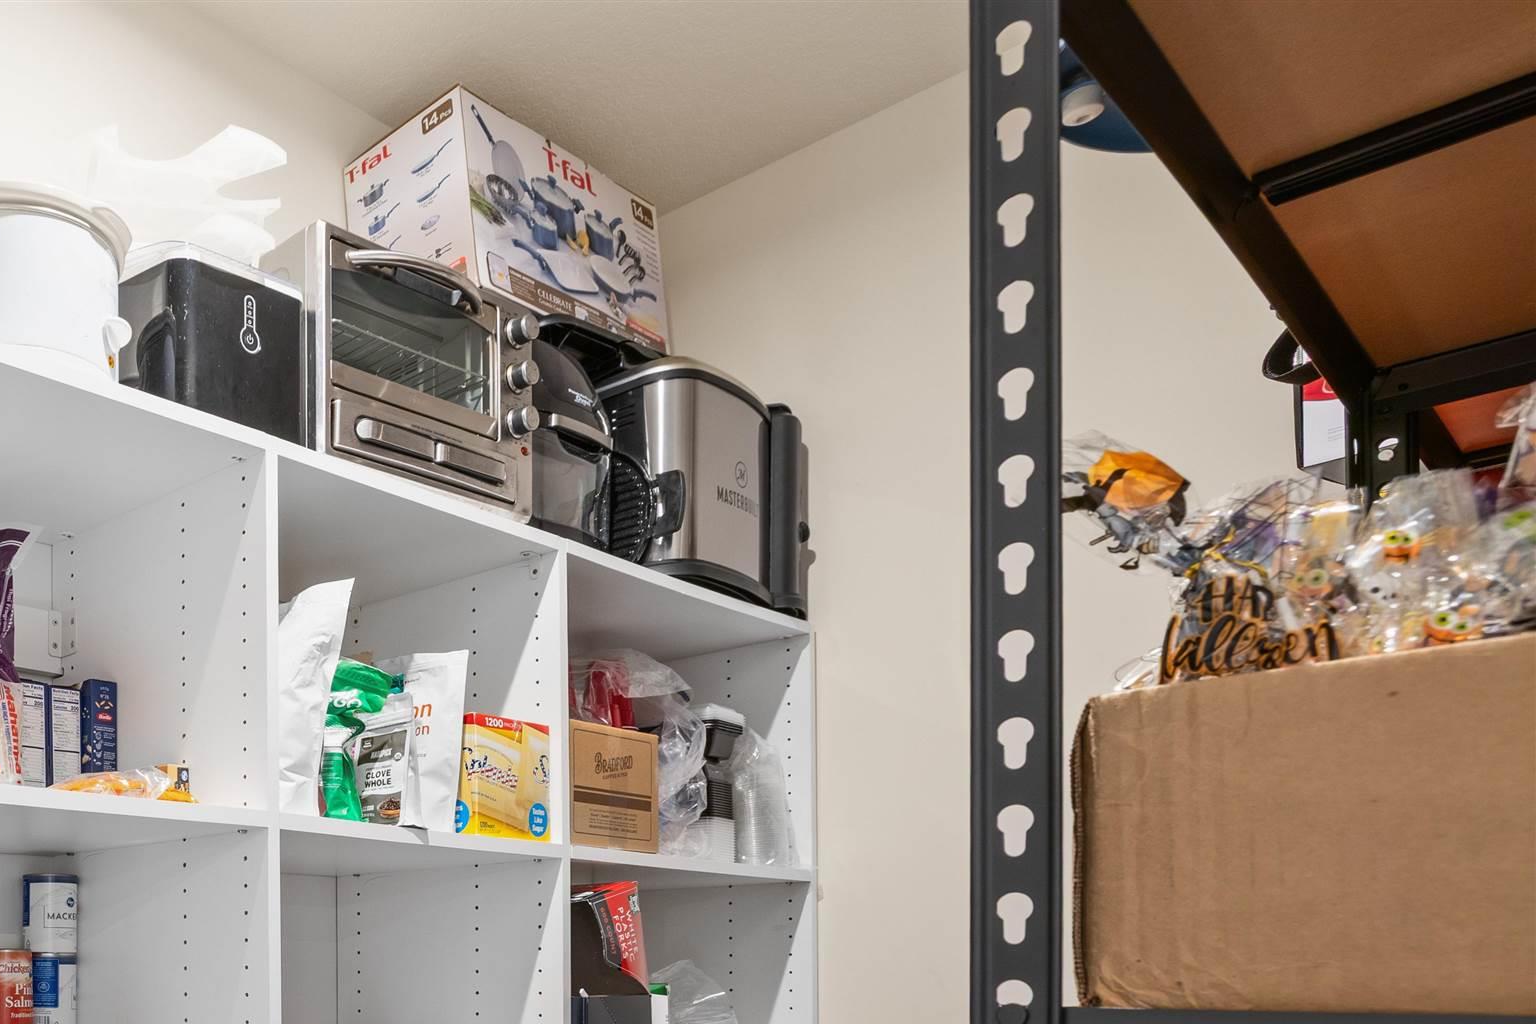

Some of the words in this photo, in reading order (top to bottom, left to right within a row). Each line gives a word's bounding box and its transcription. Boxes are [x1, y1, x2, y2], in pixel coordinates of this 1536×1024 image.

[423, 111, 439, 132] 14
[345, 145, 392, 184] T-fal
[543, 147, 597, 197] T-fal
[485, 717, 504, 728] 1200
[595, 752, 633, 774] BRADFORD
[365, 769, 391, 780] CLOVE
[365, 778, 392, 789] WHOLE
